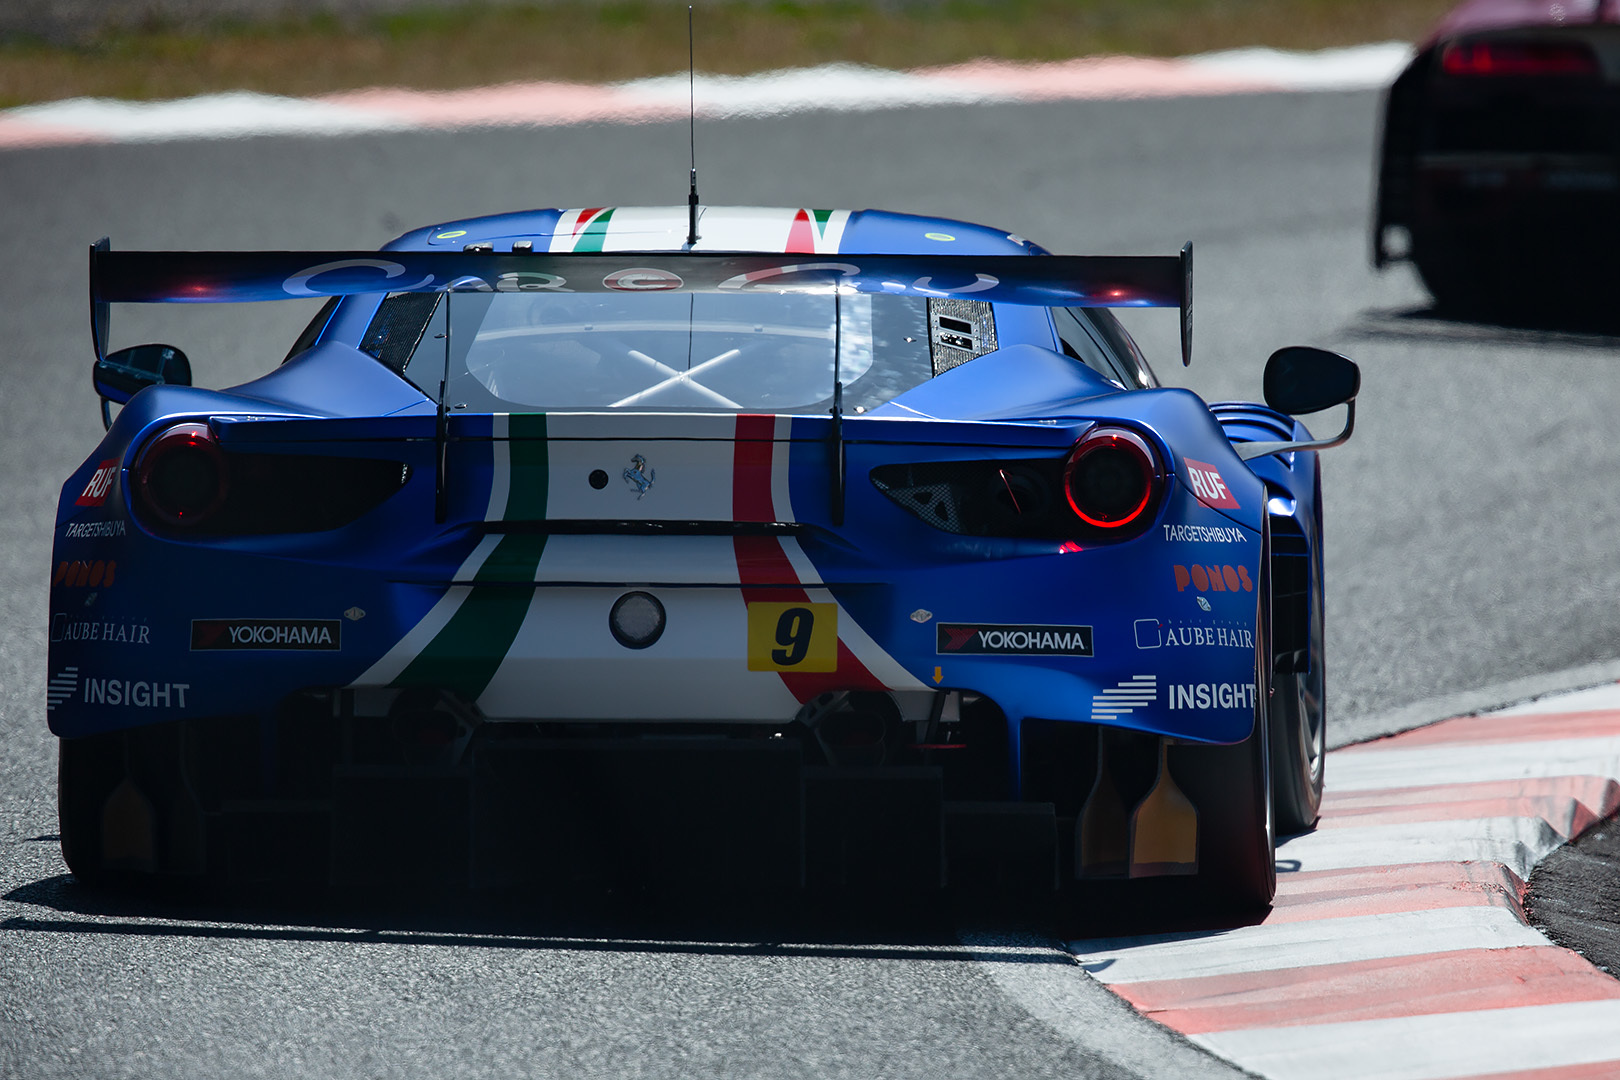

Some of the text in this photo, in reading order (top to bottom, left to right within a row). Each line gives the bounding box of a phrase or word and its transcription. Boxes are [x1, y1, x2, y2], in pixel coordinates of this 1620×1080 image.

[82, 466, 117, 498] RUF
[1187, 466, 1227, 500] RUF
[1163, 524, 1247, 543] TARGETSHIBUYA
[52, 560, 117, 588] PONOS
[1173, 564, 1253, 592] PONOS
[64, 622, 151, 644] AUBE HAIR
[228, 625, 332, 644] YOKOHAMA
[771, 607, 815, 666] 9
[977, 630, 1085, 650] YOKOHAMA
[1165, 627, 1254, 649] AUBE HAIR
[83, 677, 190, 709] INSIGHT
[1168, 682, 1255, 710] INSIGHT
